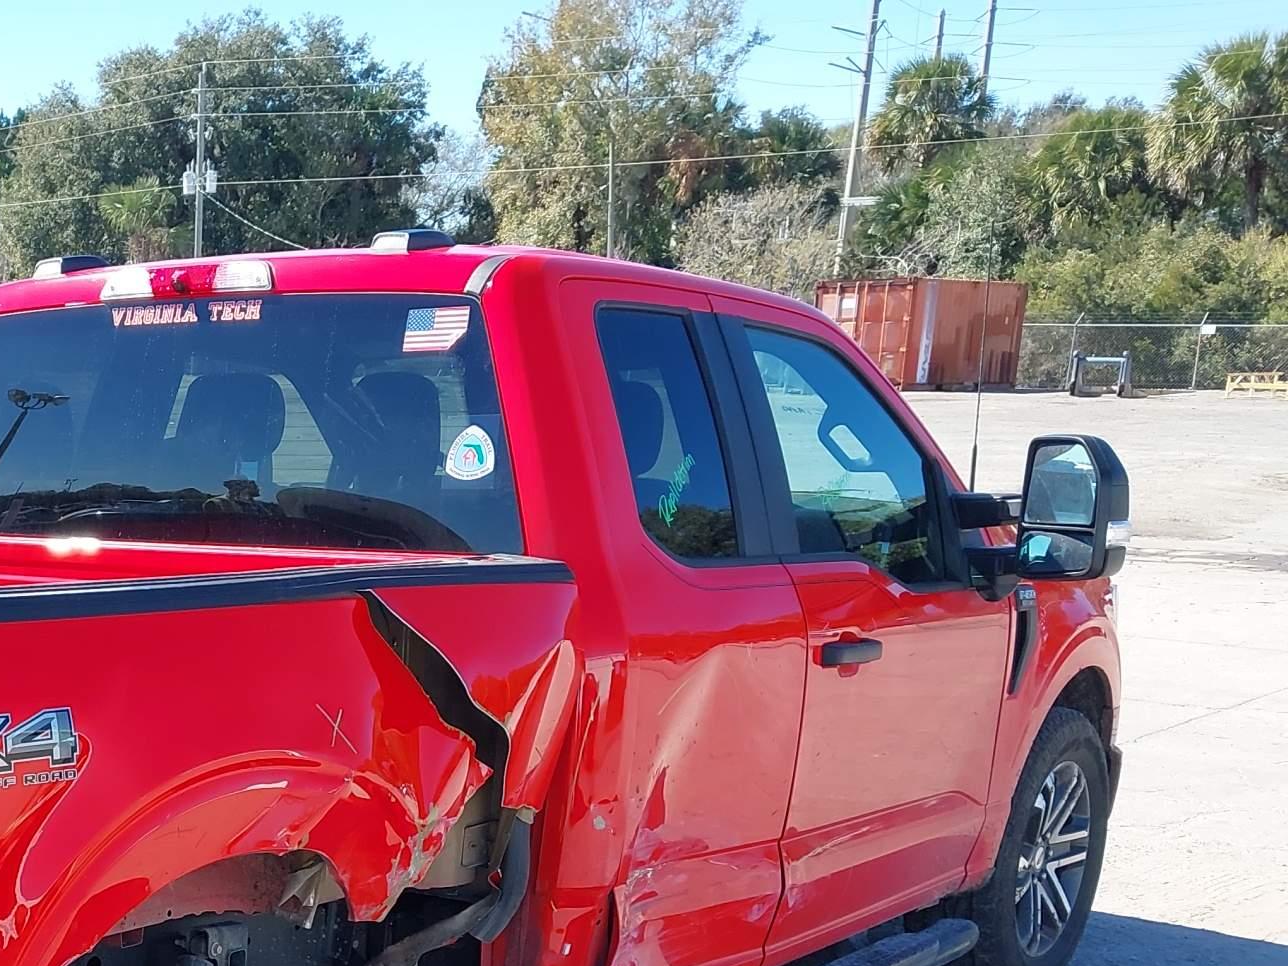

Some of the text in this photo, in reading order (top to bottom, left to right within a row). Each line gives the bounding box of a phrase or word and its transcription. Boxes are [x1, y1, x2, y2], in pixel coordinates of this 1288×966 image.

[112, 300, 262, 327] VIRGINIA TECH
[449, 431, 469, 461] FLORIDA
[480, 434, 493, 456] TRAIL
[23, 768, 78, 786] ROAD
